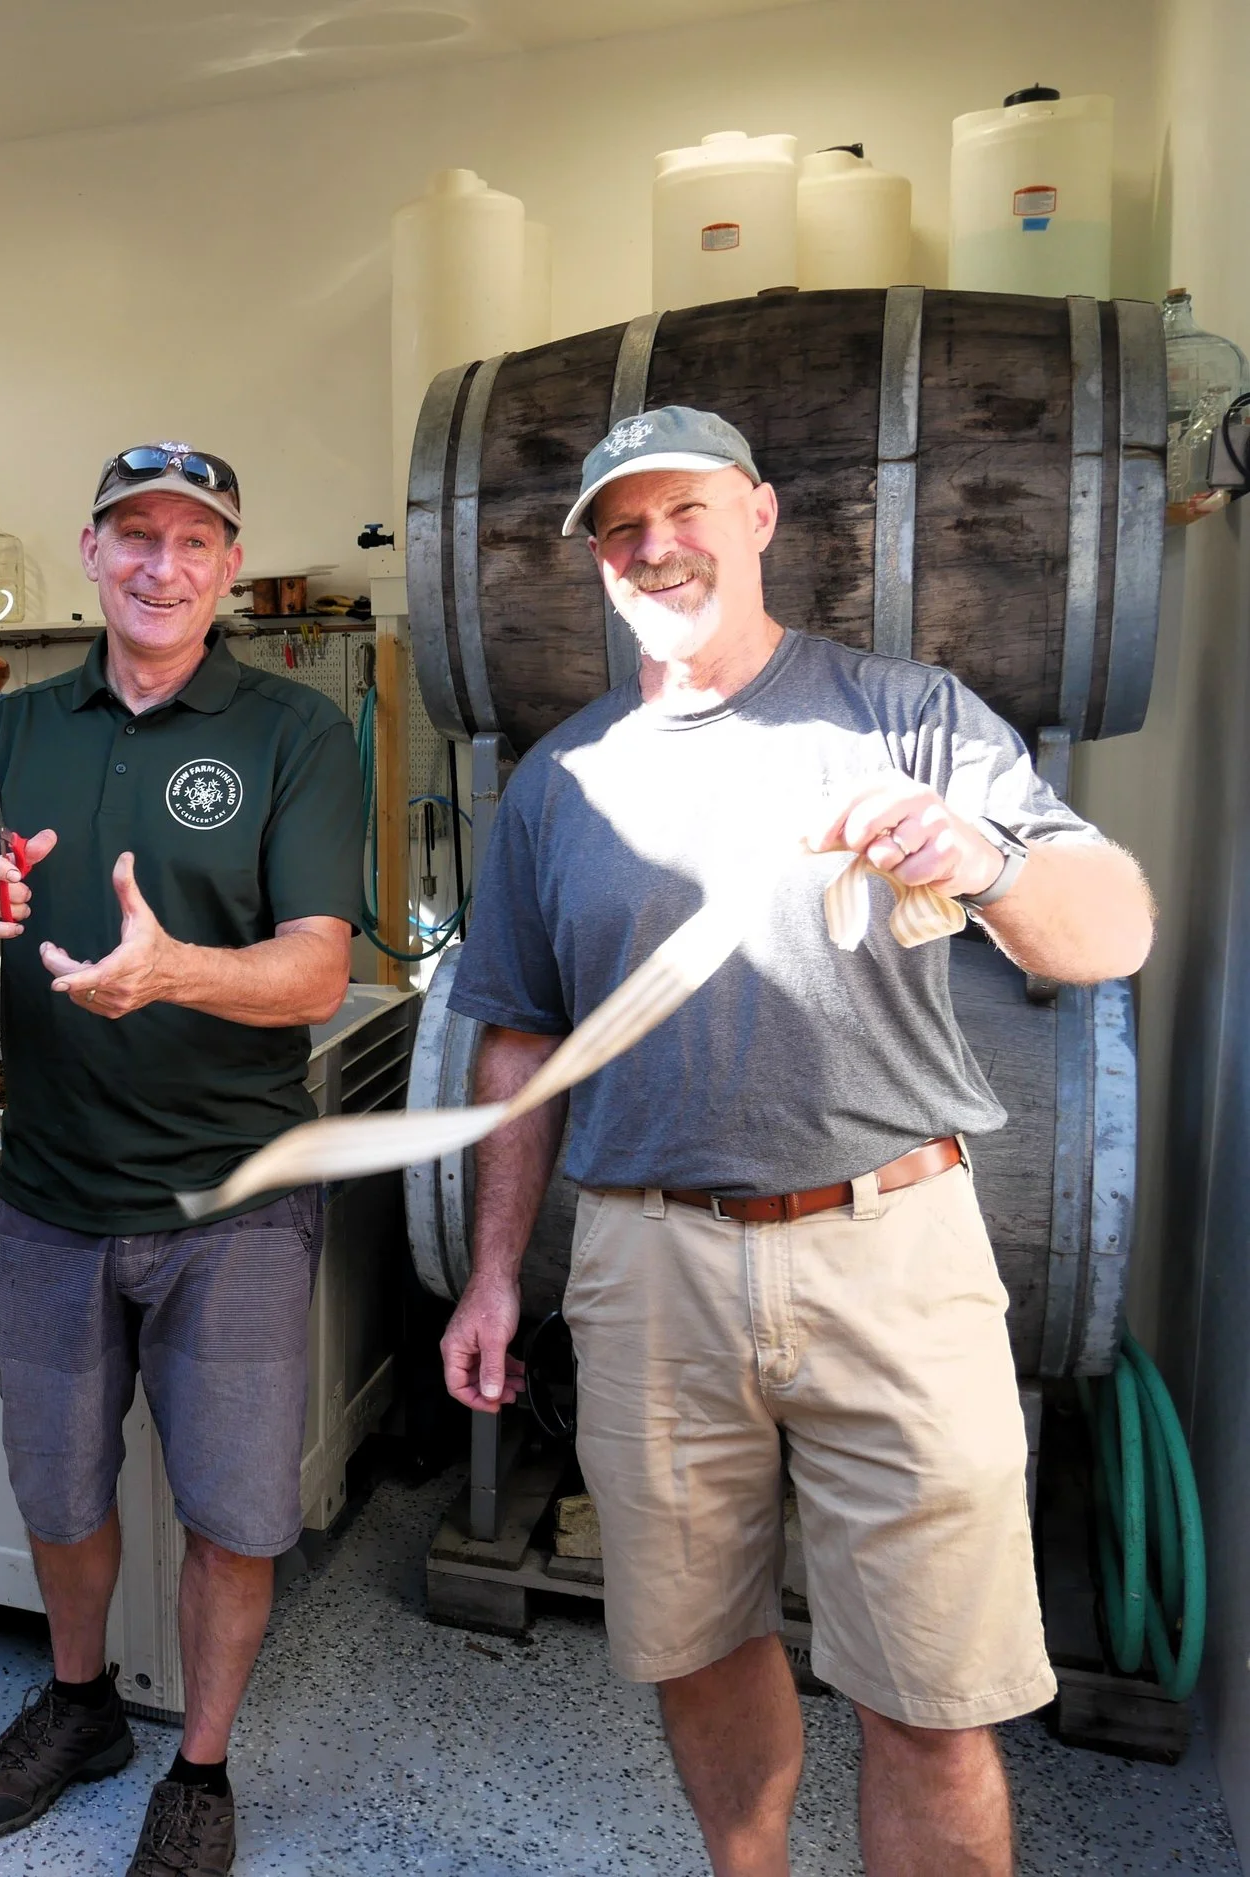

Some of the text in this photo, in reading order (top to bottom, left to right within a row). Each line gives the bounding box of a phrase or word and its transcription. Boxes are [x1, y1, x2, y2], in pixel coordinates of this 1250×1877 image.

[172, 765, 237, 805] SNOW FARM VINEYARD
[175, 803, 183, 811] AT
[180, 810, 213, 823] CRESCENT
